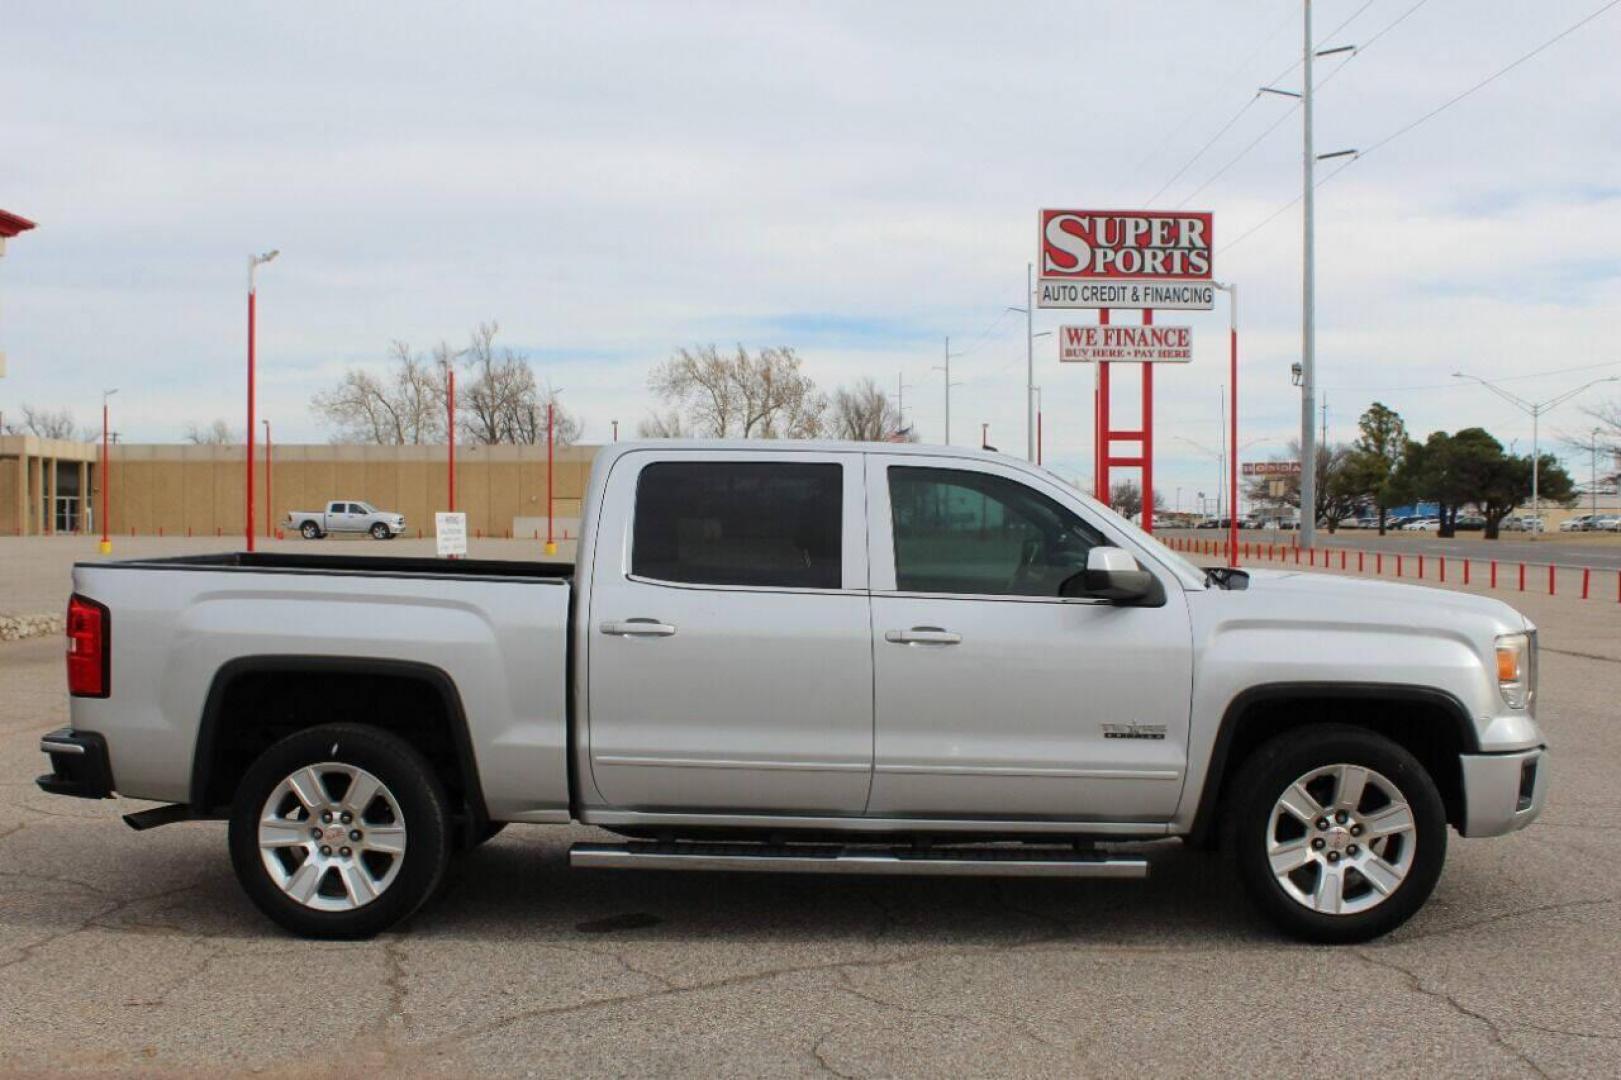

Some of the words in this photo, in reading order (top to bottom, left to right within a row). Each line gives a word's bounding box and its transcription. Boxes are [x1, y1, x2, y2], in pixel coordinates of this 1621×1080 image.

[1045, 214, 1207, 273] SUPER
[1043, 285, 1078, 302] AUTO
[1081, 285, 1127, 302] CREDIT
[1131, 287, 1140, 302] &
[1144, 287, 1212, 303] FINANCING
[1065, 327, 1097, 346] WE
[1103, 328, 1190, 347] FINANCE
[1065, 348, 1089, 358] BUY
[1092, 348, 1124, 358] HERE
[1133, 348, 1155, 358] PAY
[1158, 348, 1191, 358] HERE
